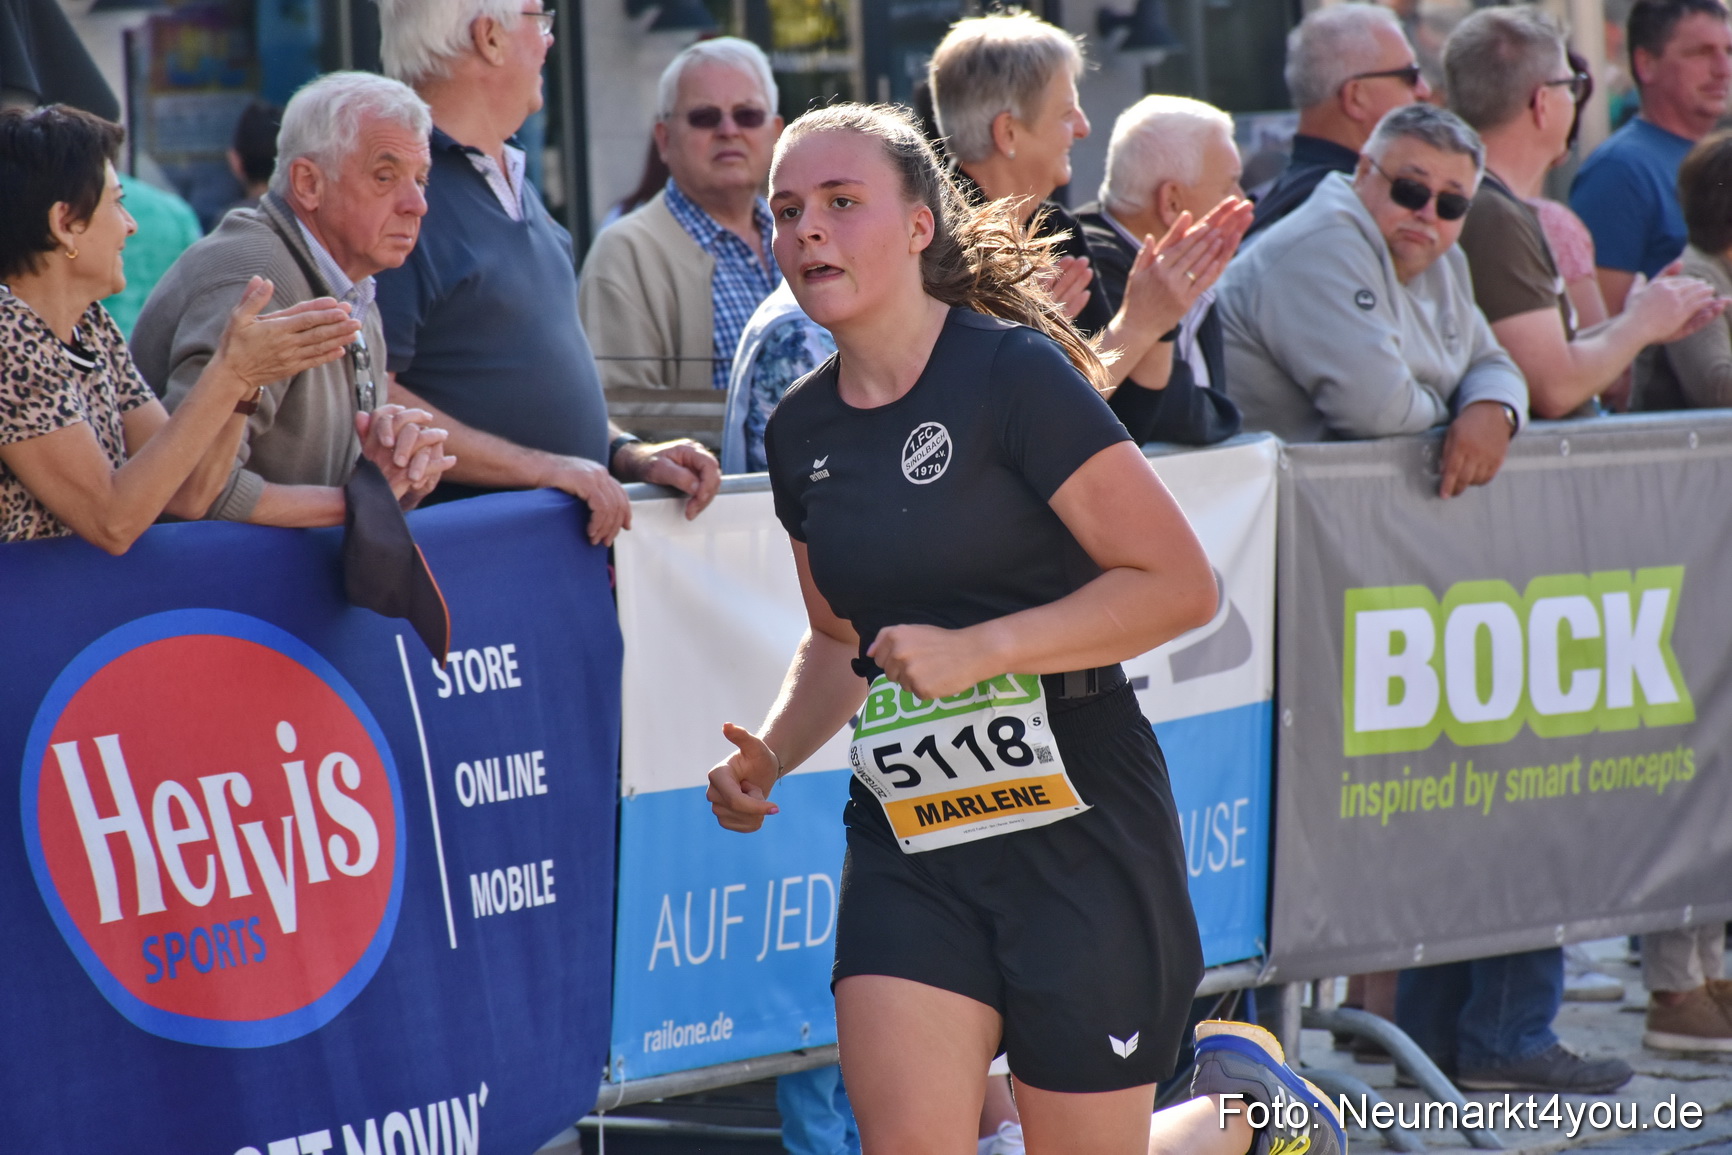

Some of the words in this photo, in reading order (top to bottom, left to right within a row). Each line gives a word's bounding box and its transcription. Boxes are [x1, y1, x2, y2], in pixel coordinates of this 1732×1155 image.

[905, 432, 945, 470] SINDLBACH
[910, 427, 933, 452] 1.FC
[809, 469, 830, 482] erima
[915, 463, 941, 477] 1970
[432, 644, 522, 698] STORE
[1354, 588, 1680, 732] BOCK
[1032, 716, 1042, 727] S
[455, 750, 548, 808] ONLINE
[872, 716, 1034, 789] 5118
[914, 785, 1051, 827] MARLENE
[1341, 761, 1457, 826] inspired
[1464, 760, 1498, 816] by
[1505, 755, 1582, 802] smart
[1588, 744, 1696, 794] concepts
[51, 721, 379, 934] Hervis
[470, 859, 556, 919] MOBILE
[142, 916, 267, 984] SPORTS
[648, 884, 746, 972] AUF
[644, 1011, 734, 1053] railone.de
